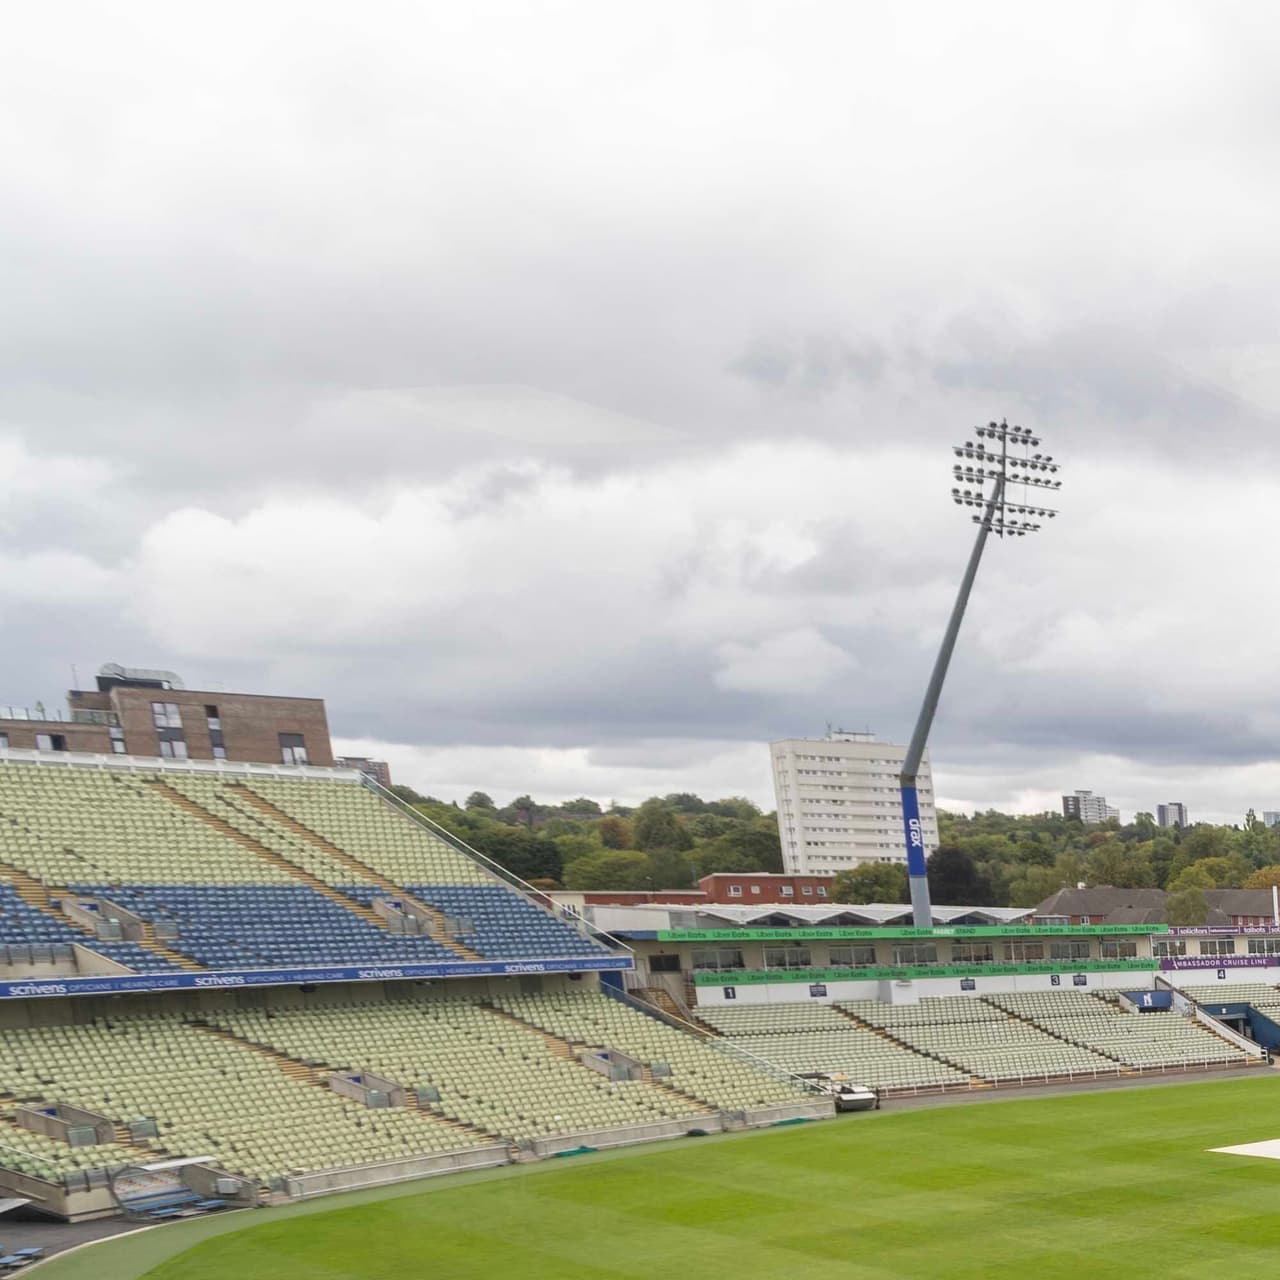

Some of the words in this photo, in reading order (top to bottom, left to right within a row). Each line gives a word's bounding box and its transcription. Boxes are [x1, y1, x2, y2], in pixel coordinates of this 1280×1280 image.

[908, 818, 922, 847] drax
[505, 962, 545, 973] scrivens
[1173, 959, 1221, 969] AMBASSADOR
[359, 968, 404, 979] scrivens
[195, 974, 245, 987] scrivens
[9, 983, 67, 996] scrivens
